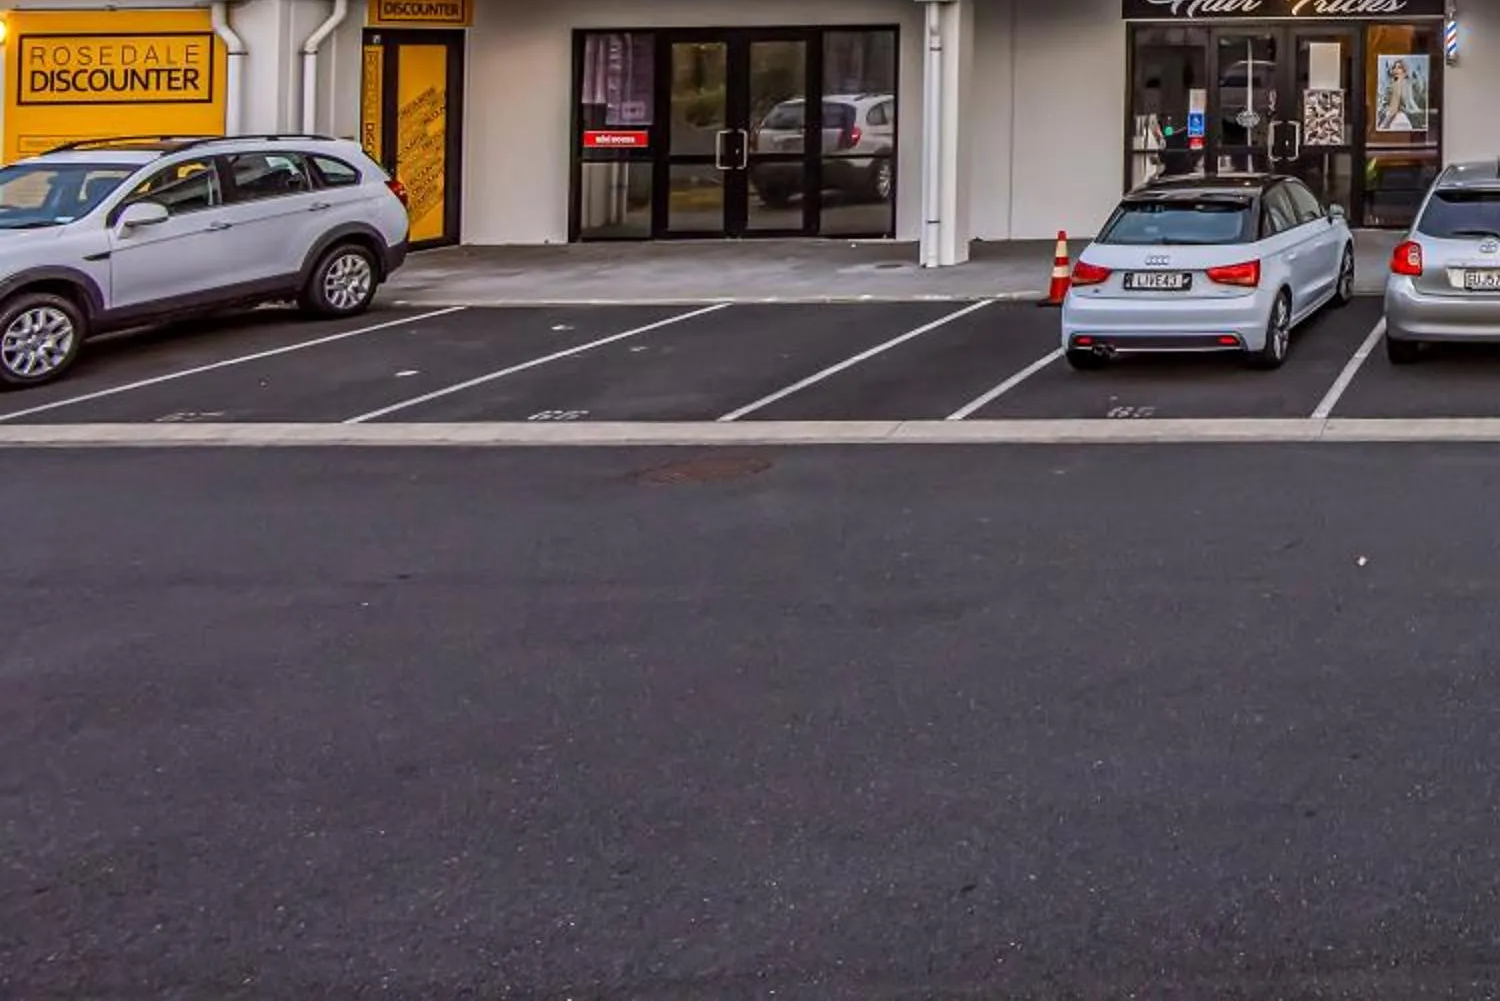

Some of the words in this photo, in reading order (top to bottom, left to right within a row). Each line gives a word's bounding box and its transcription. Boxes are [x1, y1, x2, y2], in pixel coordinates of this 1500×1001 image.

[383, 2, 460, 16] DISCOUNTER
[30, 44, 200, 66] ROSEDALE
[30, 68, 200, 92] DISCOUNTER
